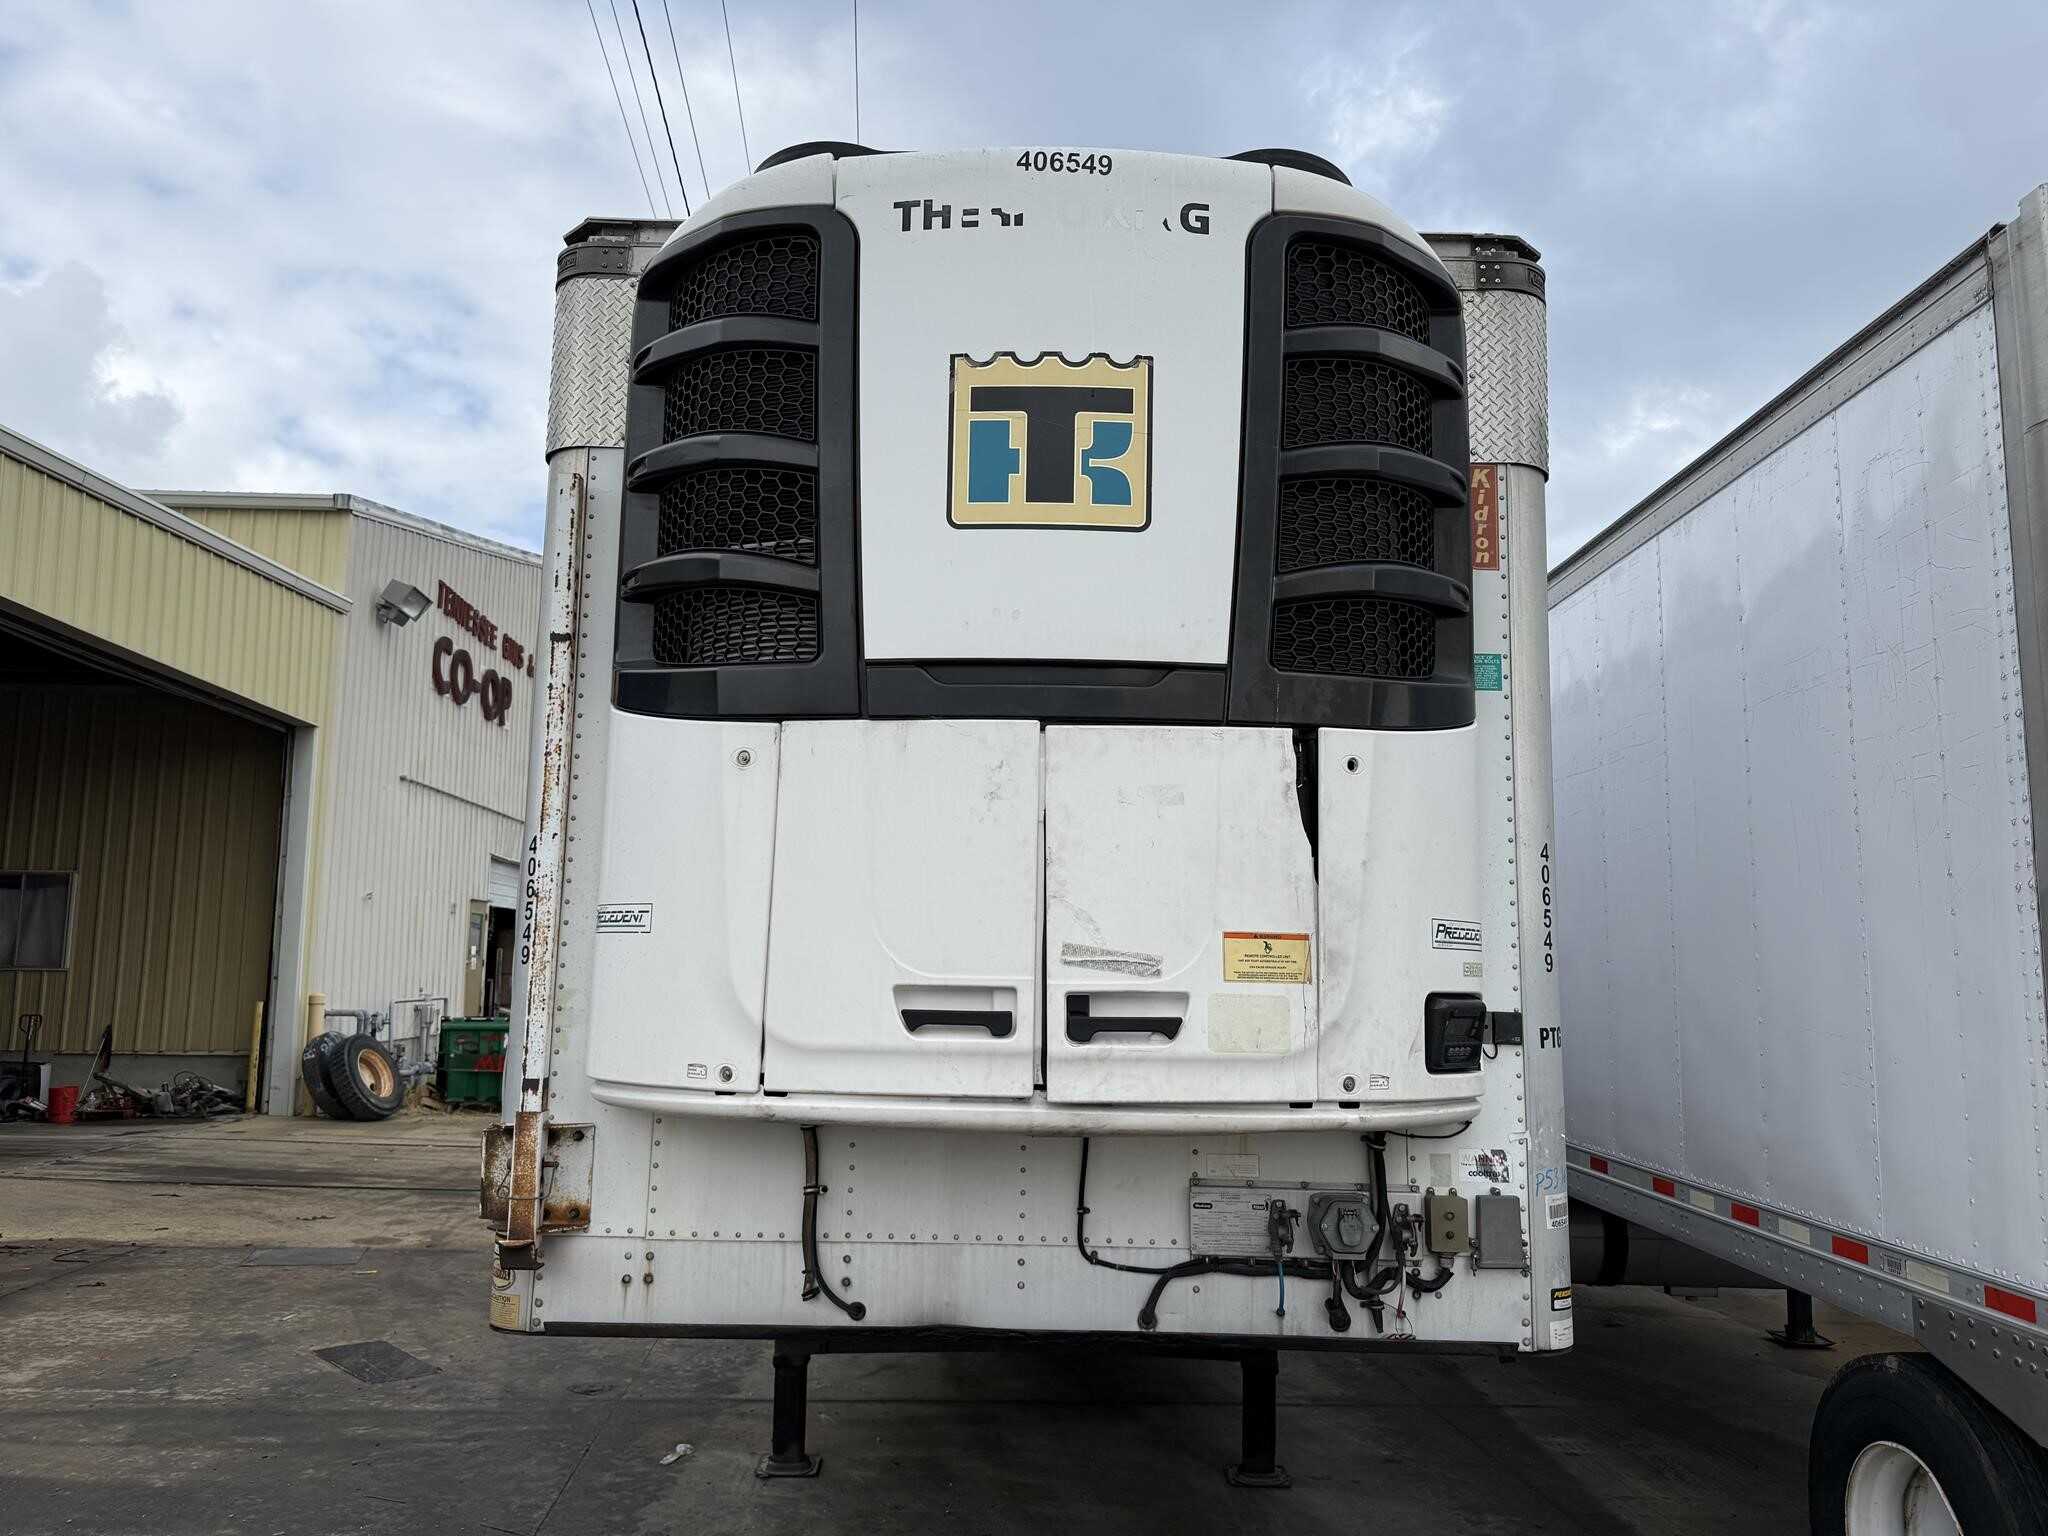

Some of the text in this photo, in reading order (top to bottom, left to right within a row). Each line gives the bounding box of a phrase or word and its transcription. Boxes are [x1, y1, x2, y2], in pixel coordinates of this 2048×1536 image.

[1016, 150, 1113, 176] 406549
[1471, 468, 1491, 564] Kidron
[521, 834, 538, 965] 406549
[1540, 843, 1554, 973] 406549
